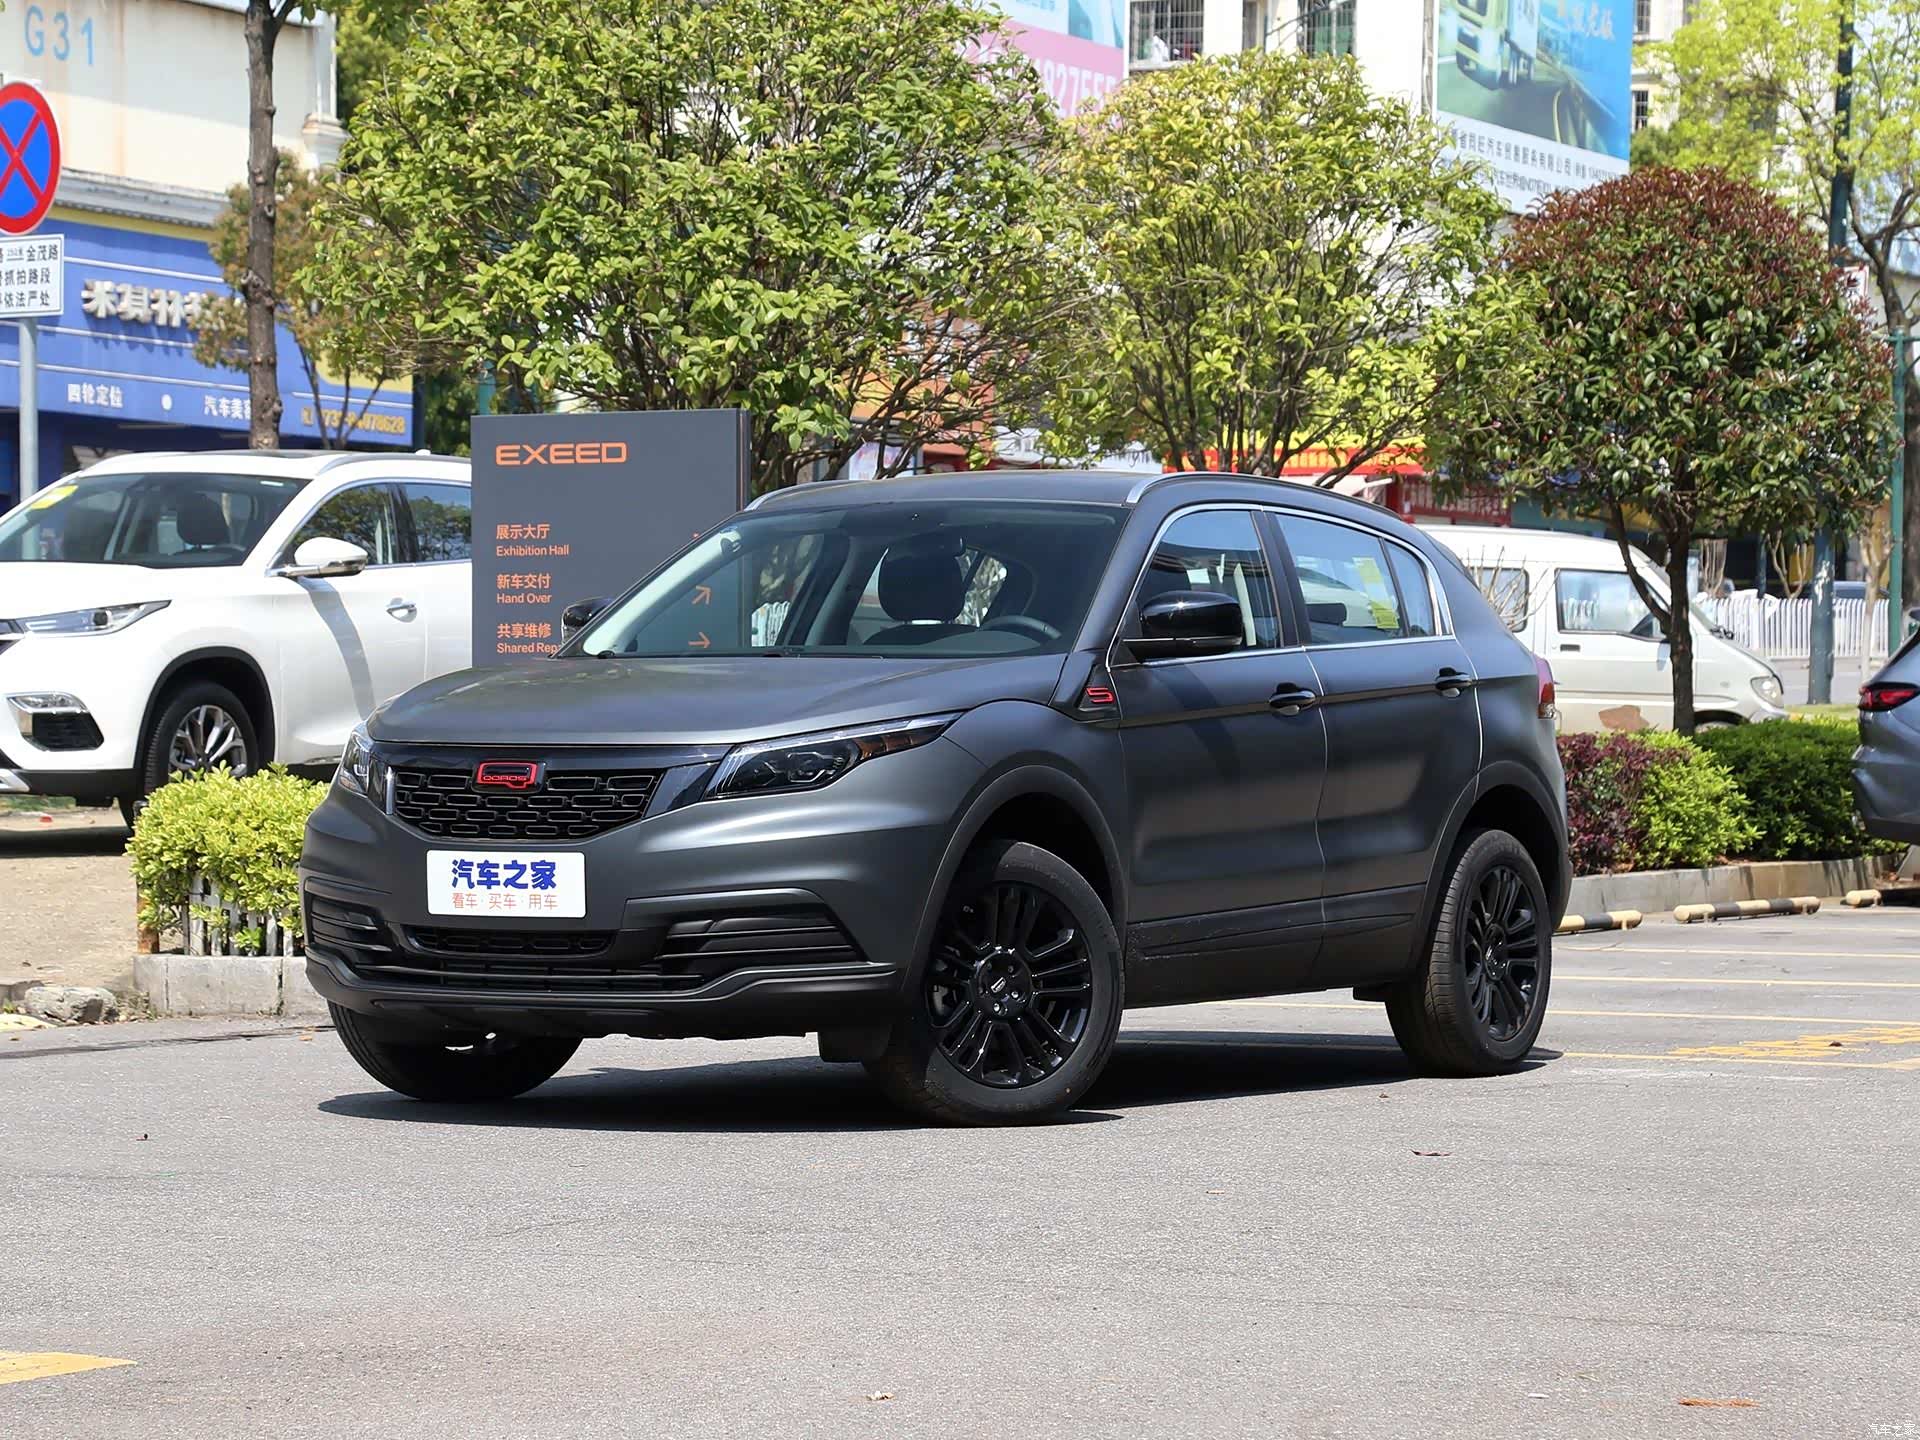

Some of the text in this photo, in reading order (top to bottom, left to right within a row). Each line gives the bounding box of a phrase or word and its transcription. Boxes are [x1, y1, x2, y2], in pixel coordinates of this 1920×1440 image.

[24, 5, 94, 66] G31
[26, 244, 58, 262] 金茂路
[0, 267, 50, 286] 抓拍路段
[0, 290, 50, 308] 依法严处
[495, 442, 628, 466] EXEED
[496, 524, 550, 540] 展示大厅
[496, 544, 570, 557] Exhibition Hall
[496, 574, 551, 590] 新车交付
[496, 593, 552, 604] Hand Over
[497, 623, 552, 639] 共享维修
[496, 642, 535, 654] Shared
[451, 859, 557, 890] 汽车之家
